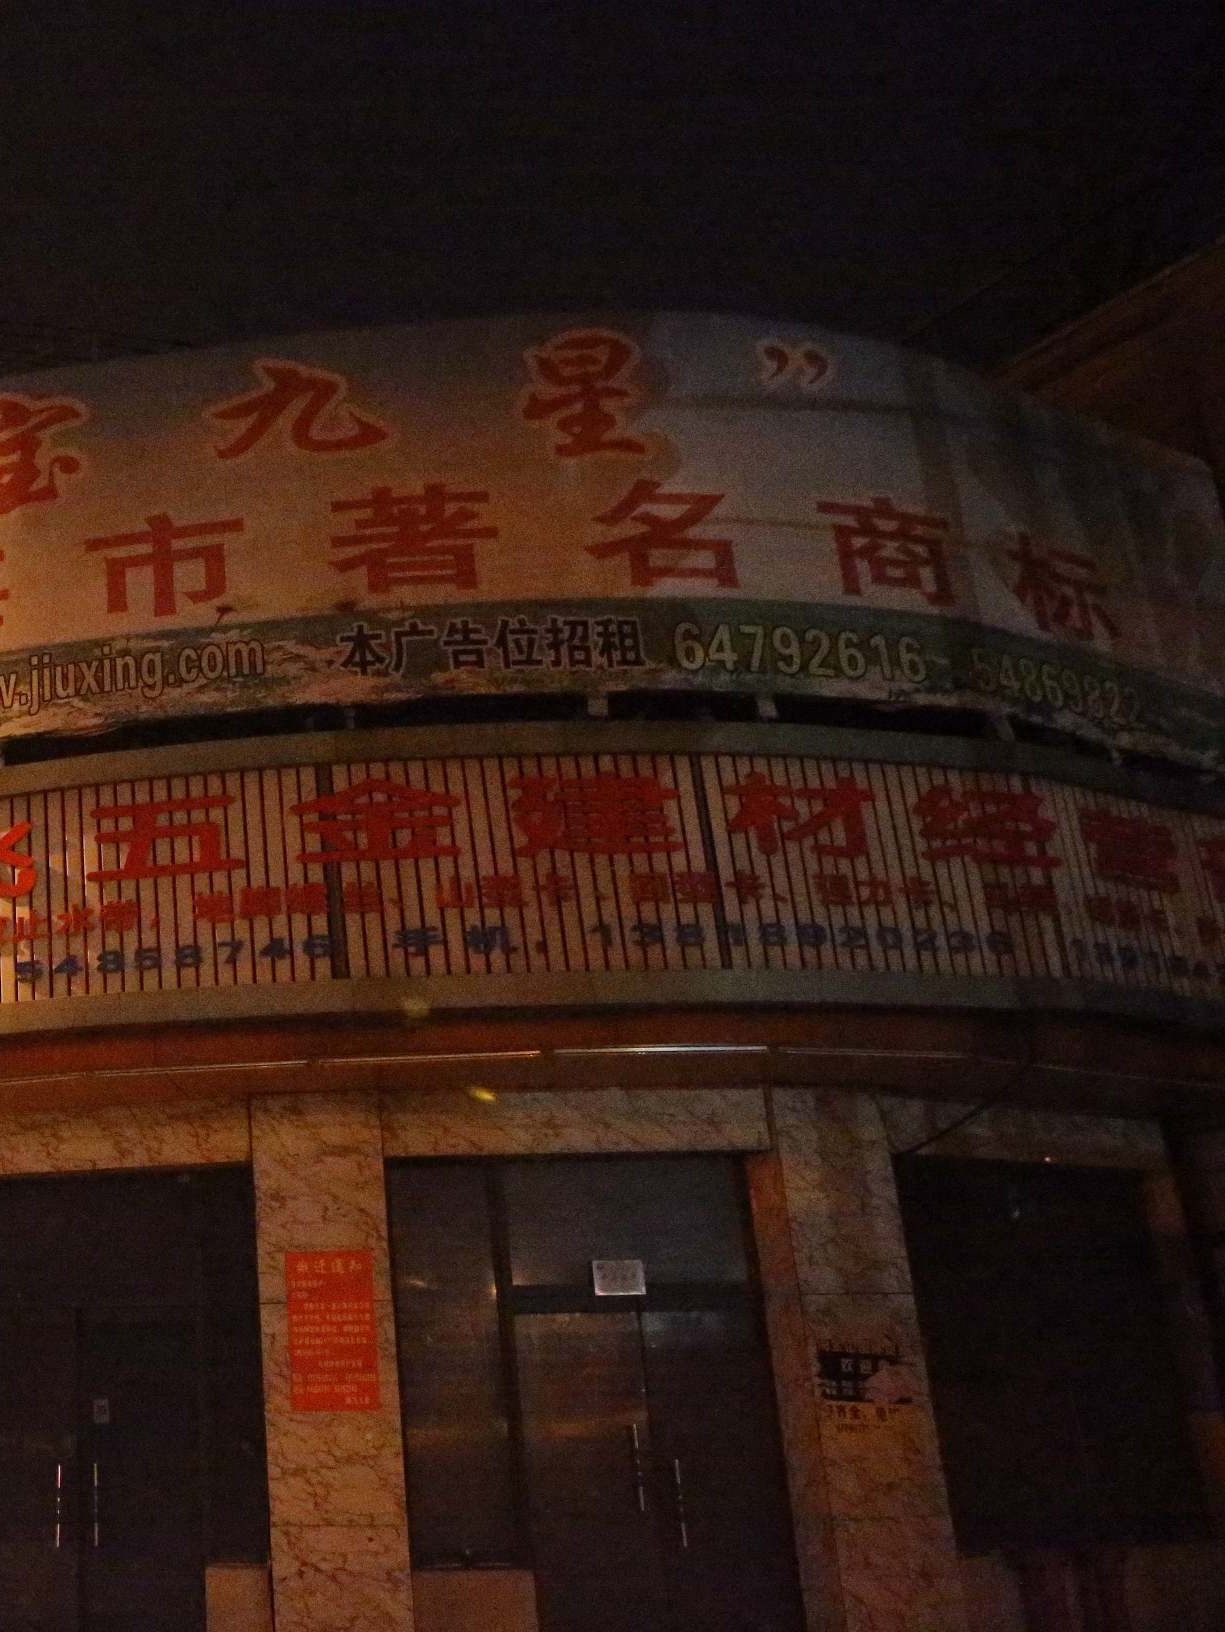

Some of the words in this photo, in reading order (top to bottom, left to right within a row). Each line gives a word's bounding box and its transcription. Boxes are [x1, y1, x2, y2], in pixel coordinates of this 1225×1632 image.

[336, 616, 646, 676] 本广告位招租
[674, 620, 928, 685] 64792616
